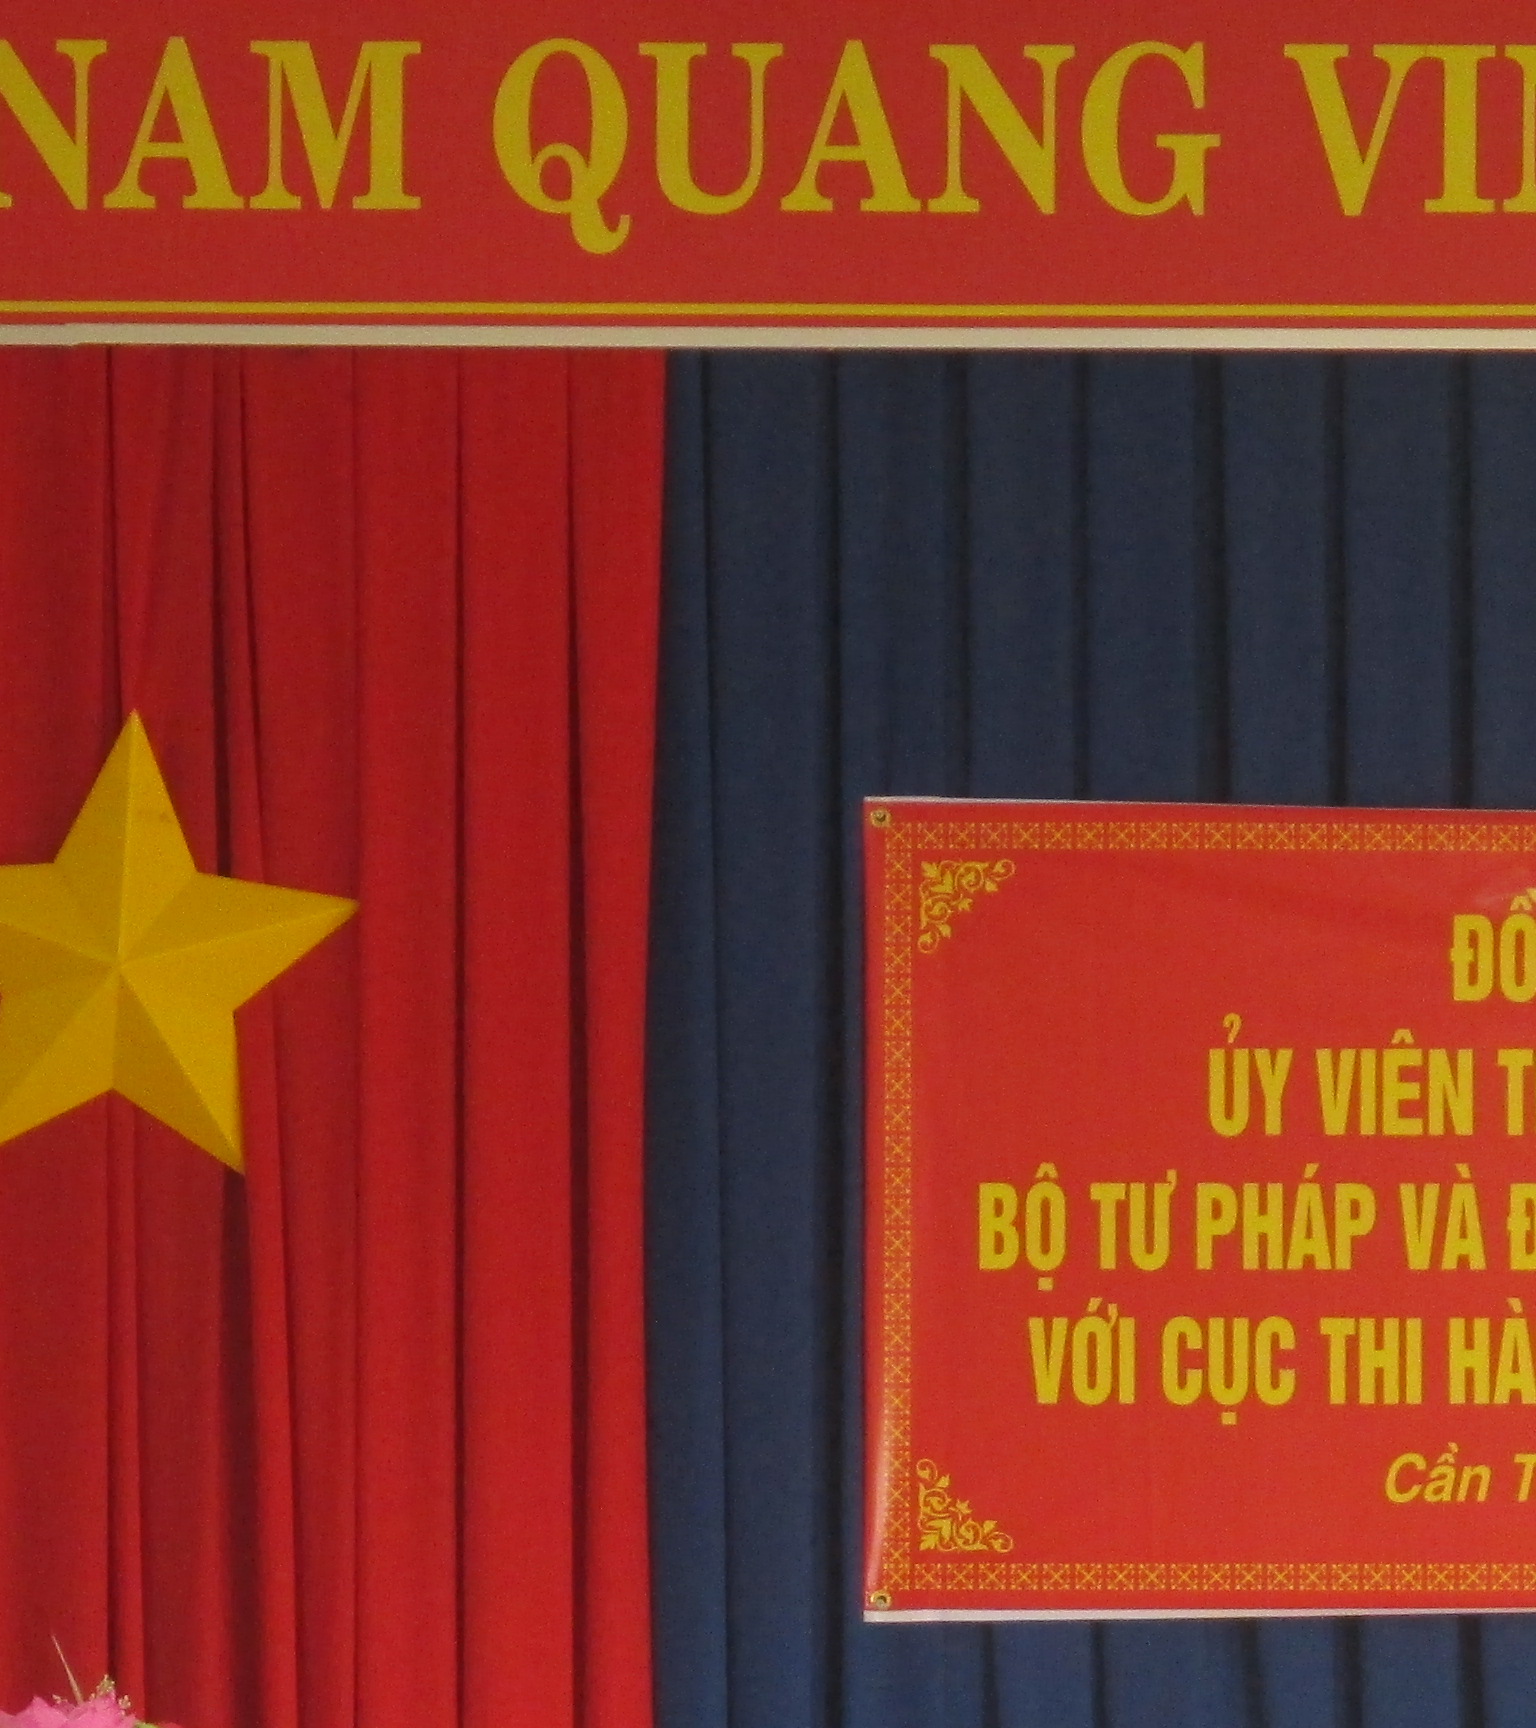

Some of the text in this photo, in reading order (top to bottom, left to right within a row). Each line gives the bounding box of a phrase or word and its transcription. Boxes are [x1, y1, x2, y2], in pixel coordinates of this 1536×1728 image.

[493, 38, 1221, 254] QUANG
[1207, 1013, 1294, 1138] ỦY
[1315, 1029, 1476, 1137] VIÊN
[977, 1163, 1068, 1290] BỘ
[1089, 1170, 1178, 1272] TƯ
[1194, 1163, 1378, 1271] PHÁP
[1398, 1164, 1487, 1271] VÀ
[1027, 1297, 1138, 1406] VỚI
[1160, 1316, 1297, 1426] CỤC
[1318, 1316, 1425, 1406] THI
[1384, 1443, 1493, 1504] Cần
